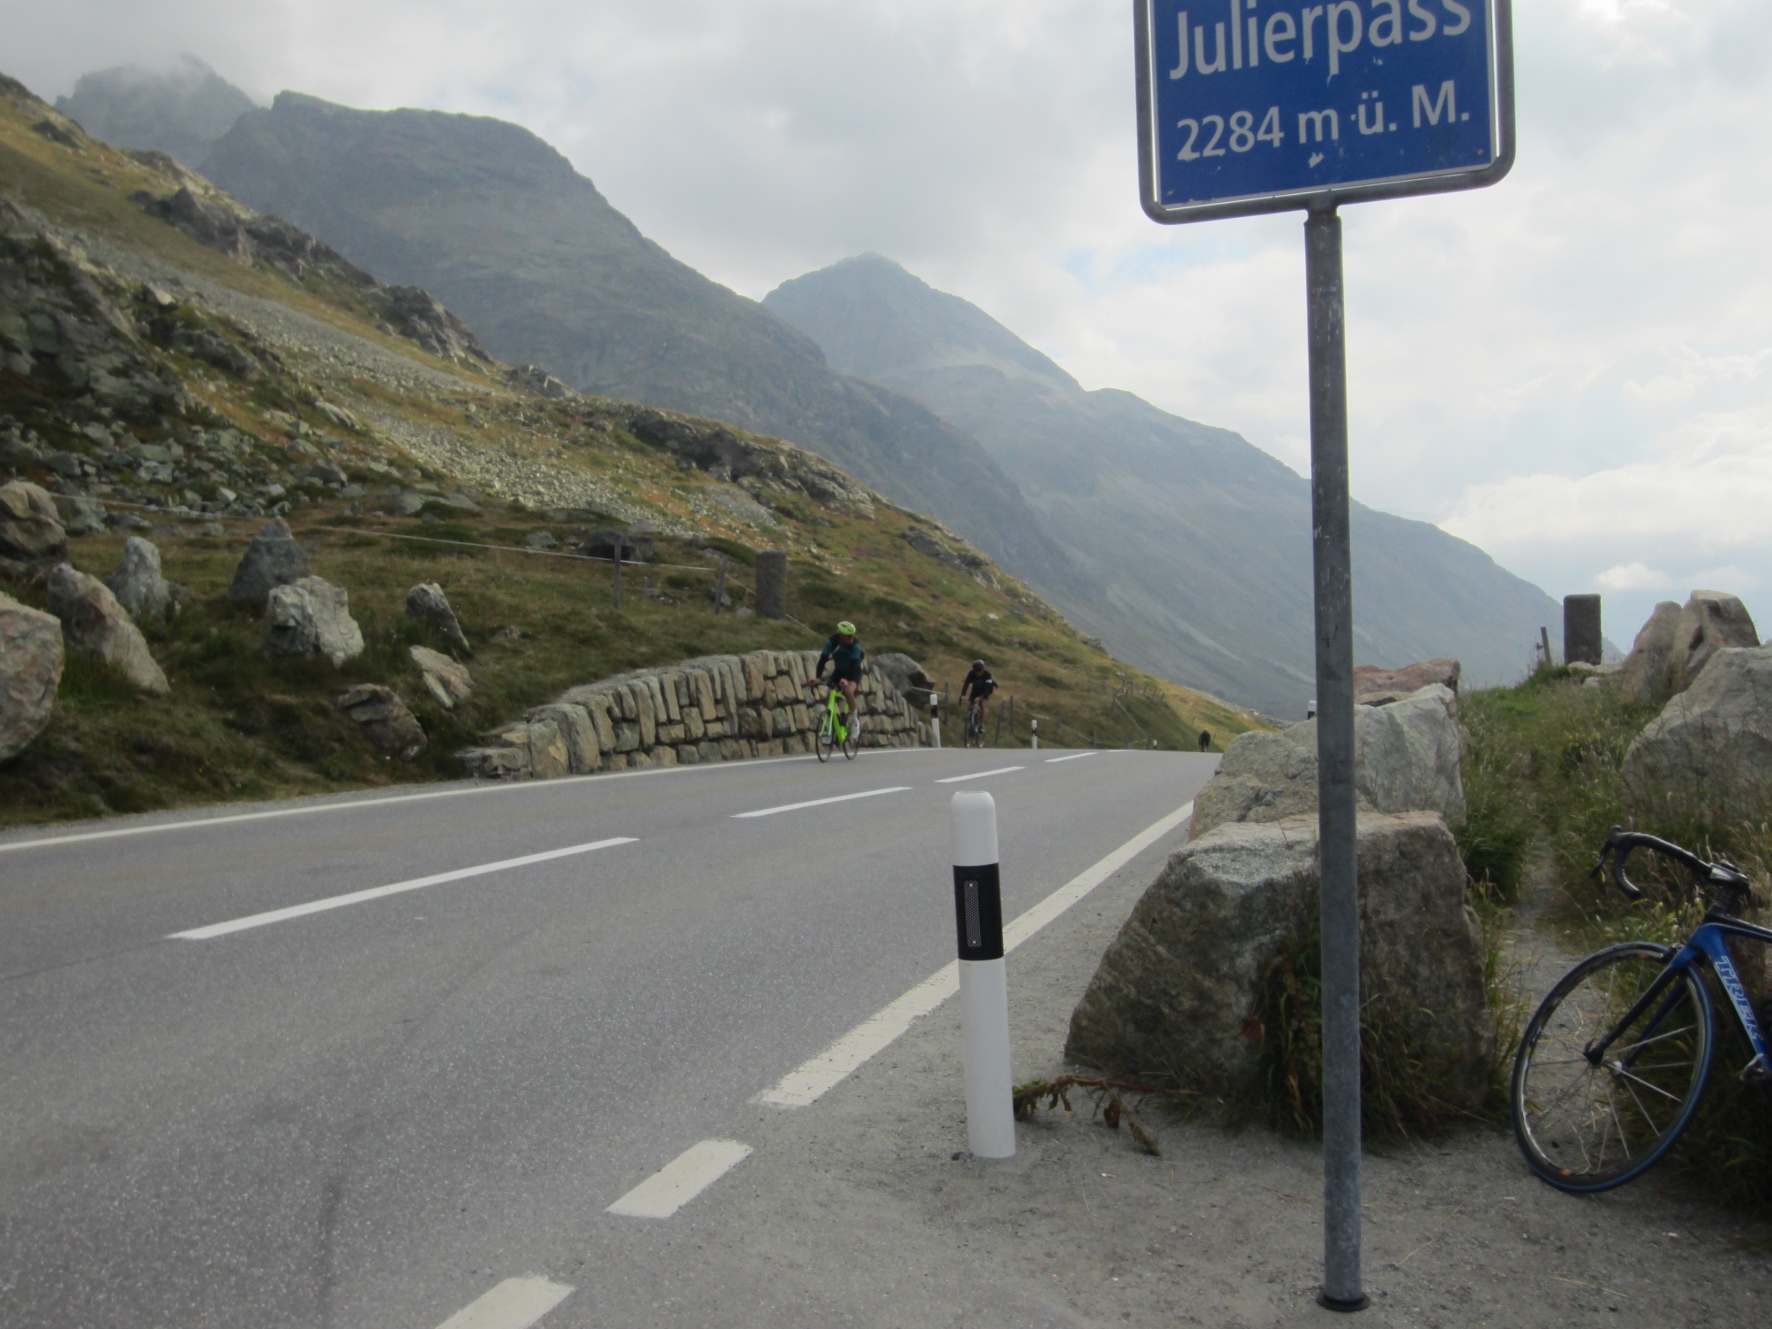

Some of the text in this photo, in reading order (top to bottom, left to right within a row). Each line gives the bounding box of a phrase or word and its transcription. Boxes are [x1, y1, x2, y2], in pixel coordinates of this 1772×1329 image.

[1169, 0, 1471, 80] Julierpass
[1176, 80, 1470, 161] 2284 m ü. M.
[1714, 955, 1763, 1041] TREK
